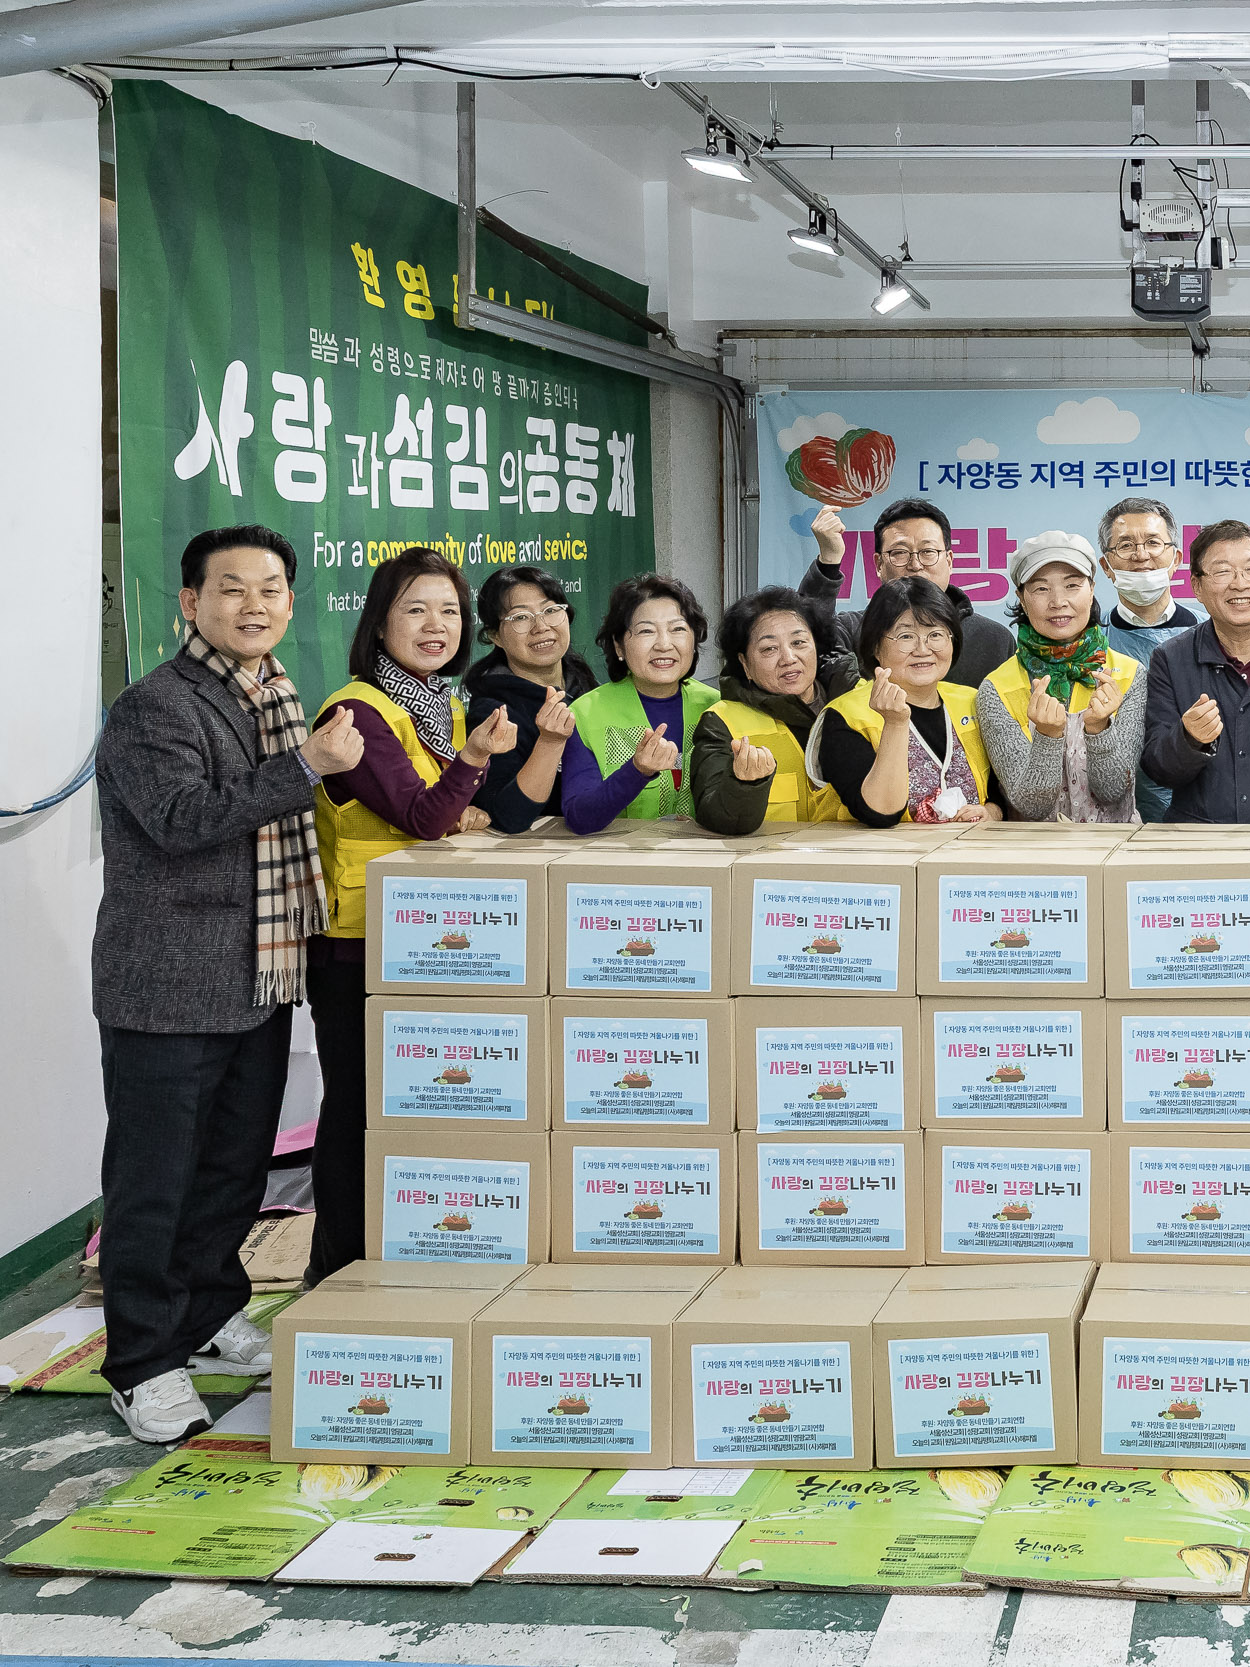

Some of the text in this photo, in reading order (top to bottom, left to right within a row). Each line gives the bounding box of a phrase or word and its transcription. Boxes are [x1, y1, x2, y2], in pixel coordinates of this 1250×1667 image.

[369, 341, 431, 382] 성령으로
[507, 374, 540, 404] 끝까지
[937, 460, 1023, 490] 자양동
[1030, 460, 1085, 489] 지역
[1093, 459, 1176, 488] 주민의
[313, 532, 346, 568] For
[352, 543, 363, 567] a
[468, 533, 483, 565] of
[485, 533, 516, 564] love
[395, 908, 517, 927] 사랑의 김장나누기
[579, 915, 702, 933] 사랑의 김장나누기
[765, 911, 890, 932] 사랑의 김장나누기
[951, 907, 1078, 923] 사랑의 김장나누기
[1140, 913, 1184, 928] 사랑의
[395, 1043, 518, 1062] 사랑의 김장나누기
[947, 1043, 1073, 1058] 사랑의 김장나누기
[770, 1175, 895, 1191] 사랑의 김장나누기
[310, 1349, 437, 1364] 자양동 지역 주민의 따뜻한 겨울나기를 위한
[307, 1368, 442, 1391] 사랑의 김장나누기
[506, 1370, 641, 1389] 사랑의 김장나누기
[706, 1377, 841, 1396] 사랑의 김장나누기
[904, 1369, 1041, 1390] 사랑의 김장나누기
[1116, 1373, 1164, 1391] 사랑의
